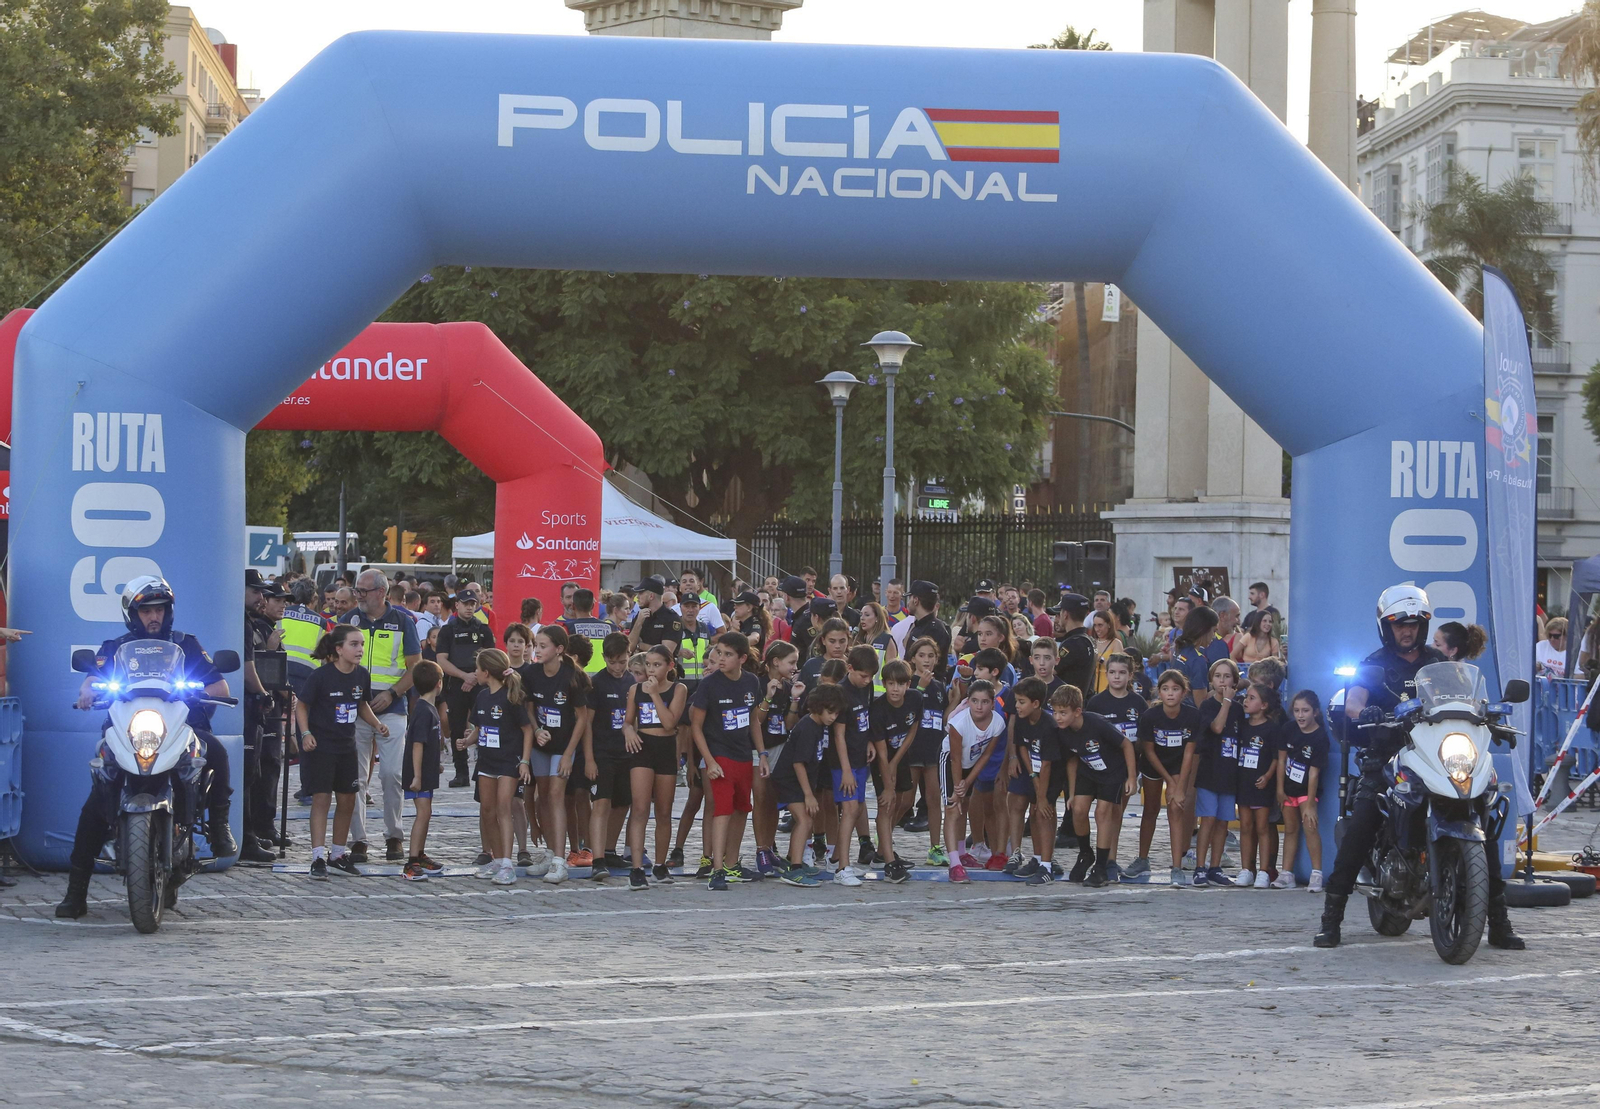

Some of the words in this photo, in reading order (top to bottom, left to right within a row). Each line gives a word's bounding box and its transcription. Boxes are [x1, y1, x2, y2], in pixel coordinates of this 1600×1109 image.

[746, 165, 1058, 202] NACIONAL
[311, 352, 428, 381] tander
[72, 412, 166, 473] RUTA
[1390, 440, 1479, 499] RUTA
[928, 498, 950, 509] LIBRE
[541, 510, 587, 528] Sports
[536, 536, 599, 551] Santander
